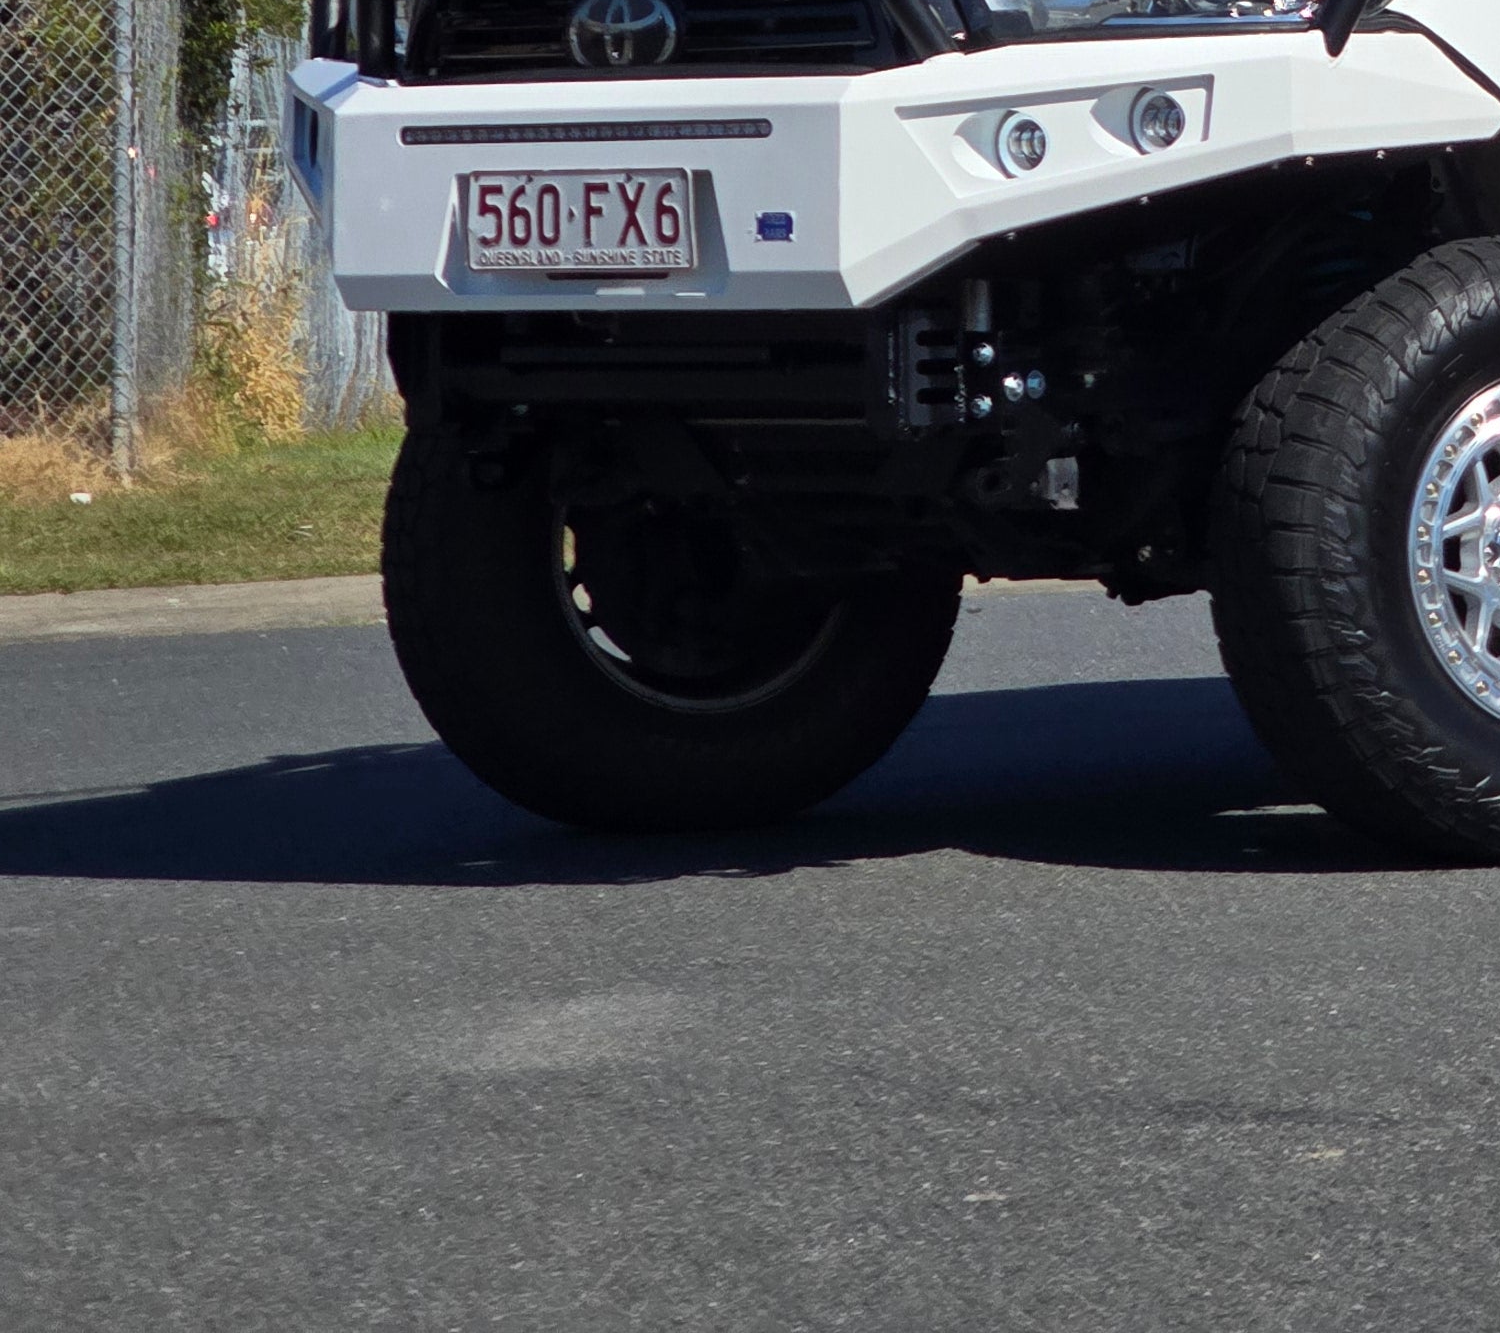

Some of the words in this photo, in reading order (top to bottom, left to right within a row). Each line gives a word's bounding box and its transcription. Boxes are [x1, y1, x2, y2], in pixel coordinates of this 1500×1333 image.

[478, 184, 561, 247] 560
[583, 182, 681, 247] FX6
[479, 249, 562, 266] QUEENSLAND
[574, 249, 637, 265] SUNSHINE
[641, 249, 683, 265] STATE
